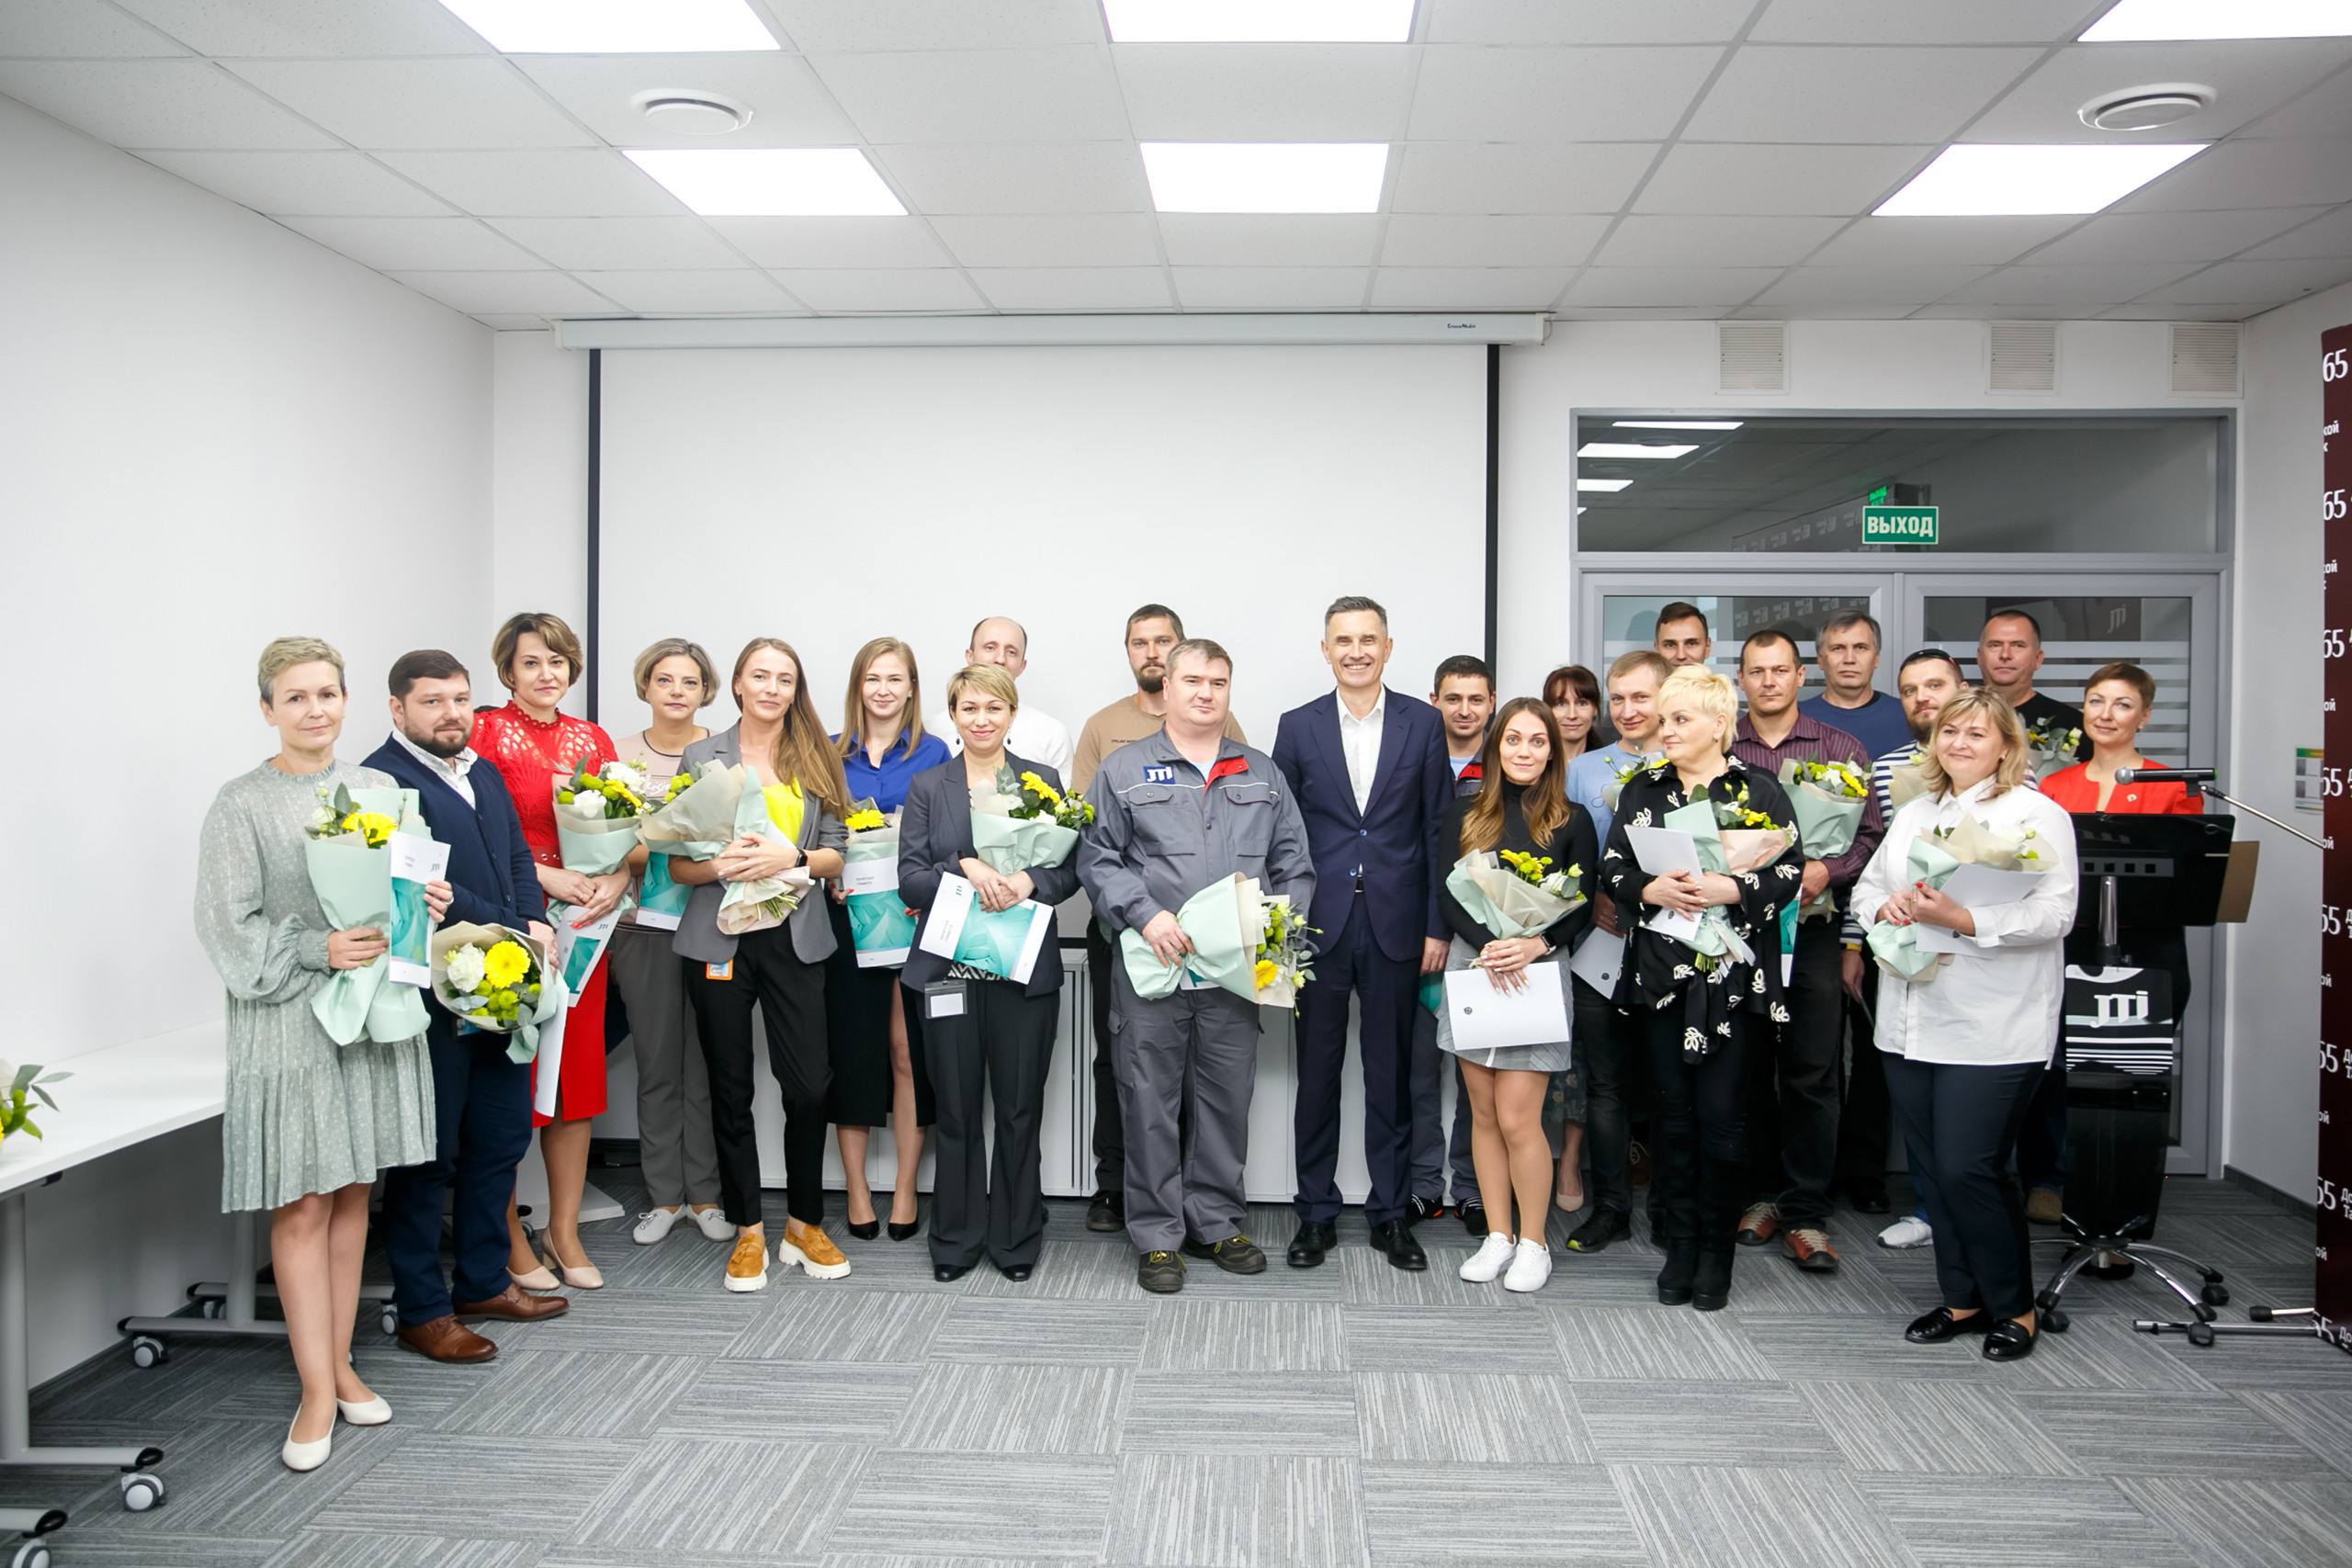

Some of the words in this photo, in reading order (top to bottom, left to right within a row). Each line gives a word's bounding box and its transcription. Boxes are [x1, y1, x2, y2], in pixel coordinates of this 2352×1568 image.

[2323, 348, 2348, 382] 65
[2324, 489, 2346, 521] 65
[1867, 515, 1933, 537] ВЫХОД
[2324, 628, 2345, 659] 65
